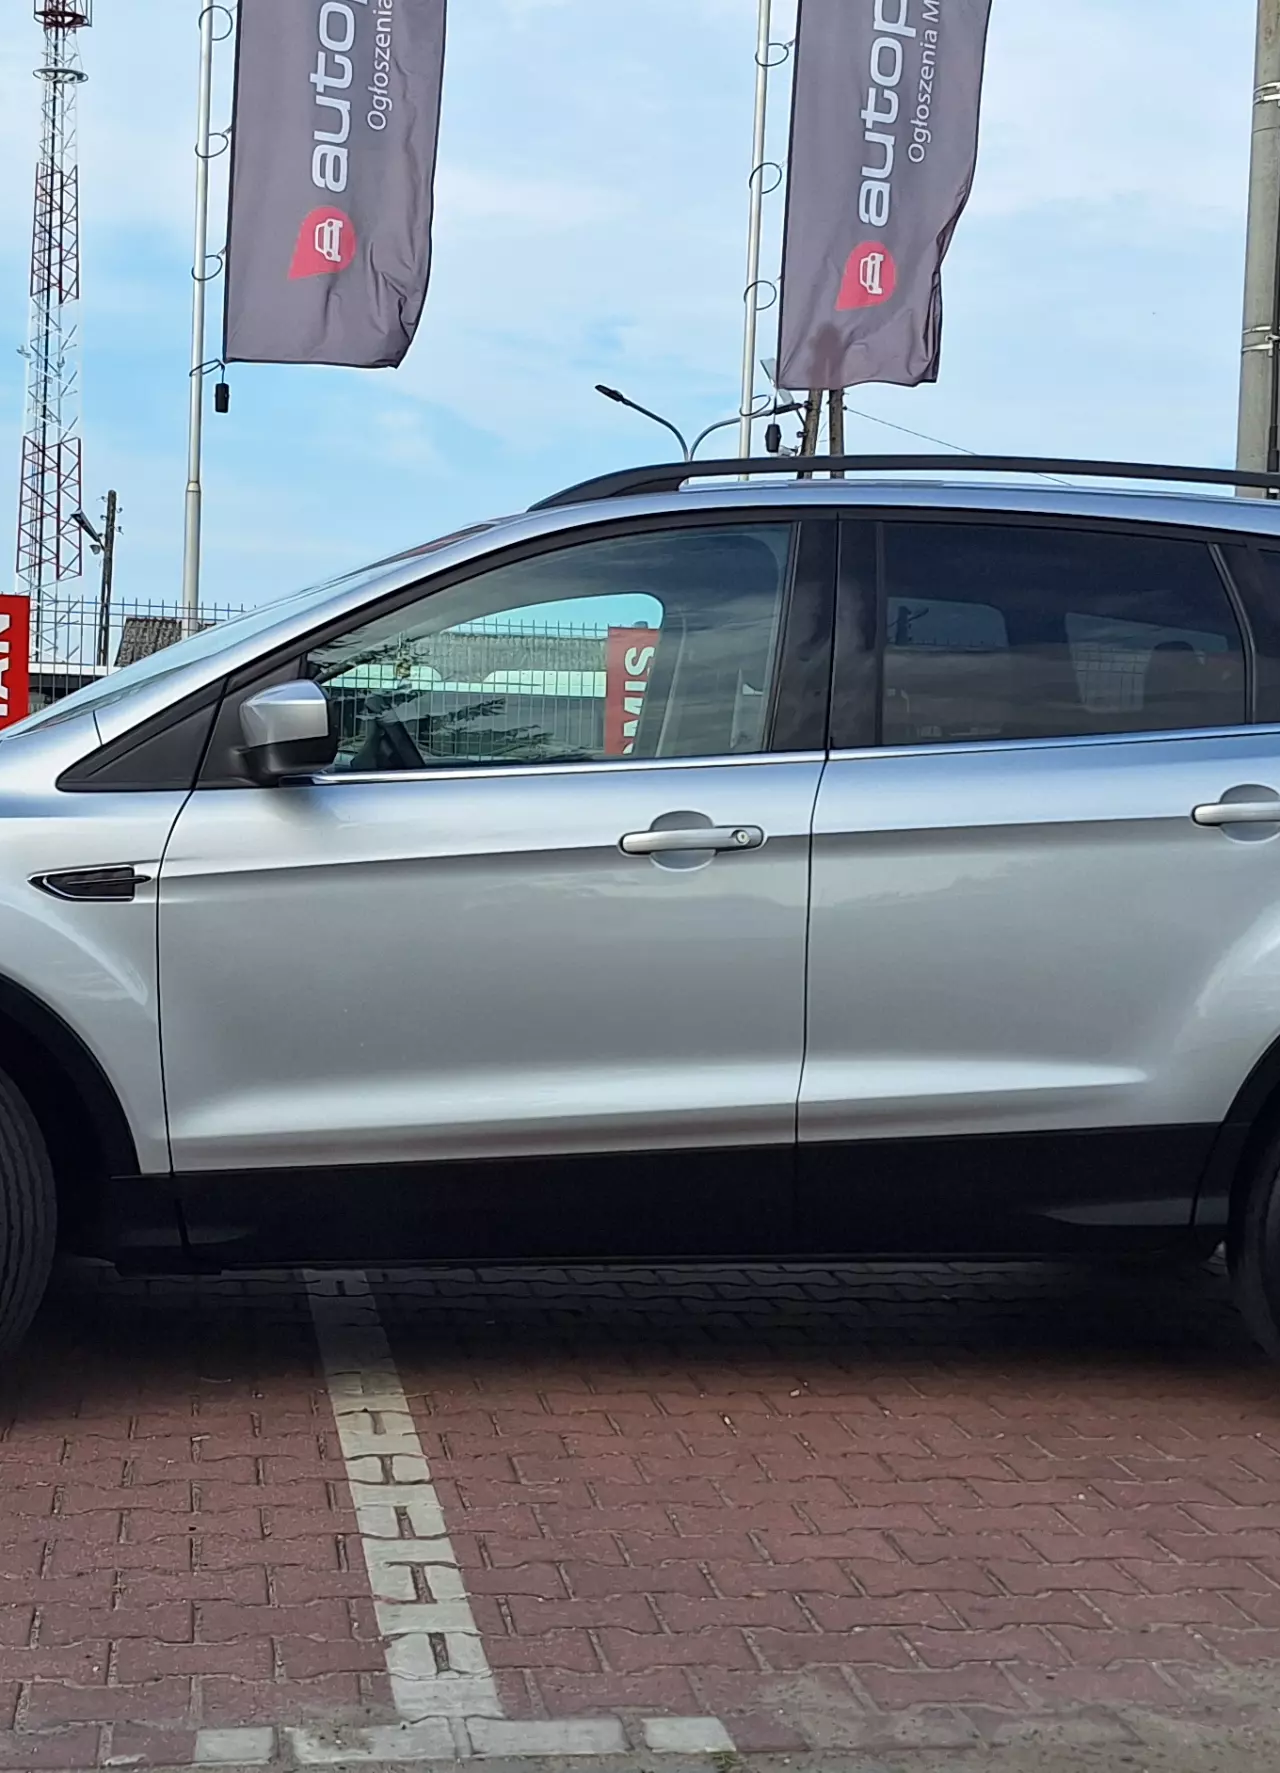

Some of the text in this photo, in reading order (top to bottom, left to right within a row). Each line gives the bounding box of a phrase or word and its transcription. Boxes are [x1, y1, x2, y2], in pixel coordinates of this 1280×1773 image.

[309, 0, 368, 193] auto
[366, 0, 393, 131] Ogłoszenia
[858, 0, 917, 228] autop
[907, 29, 939, 163] Ogłoszenia
